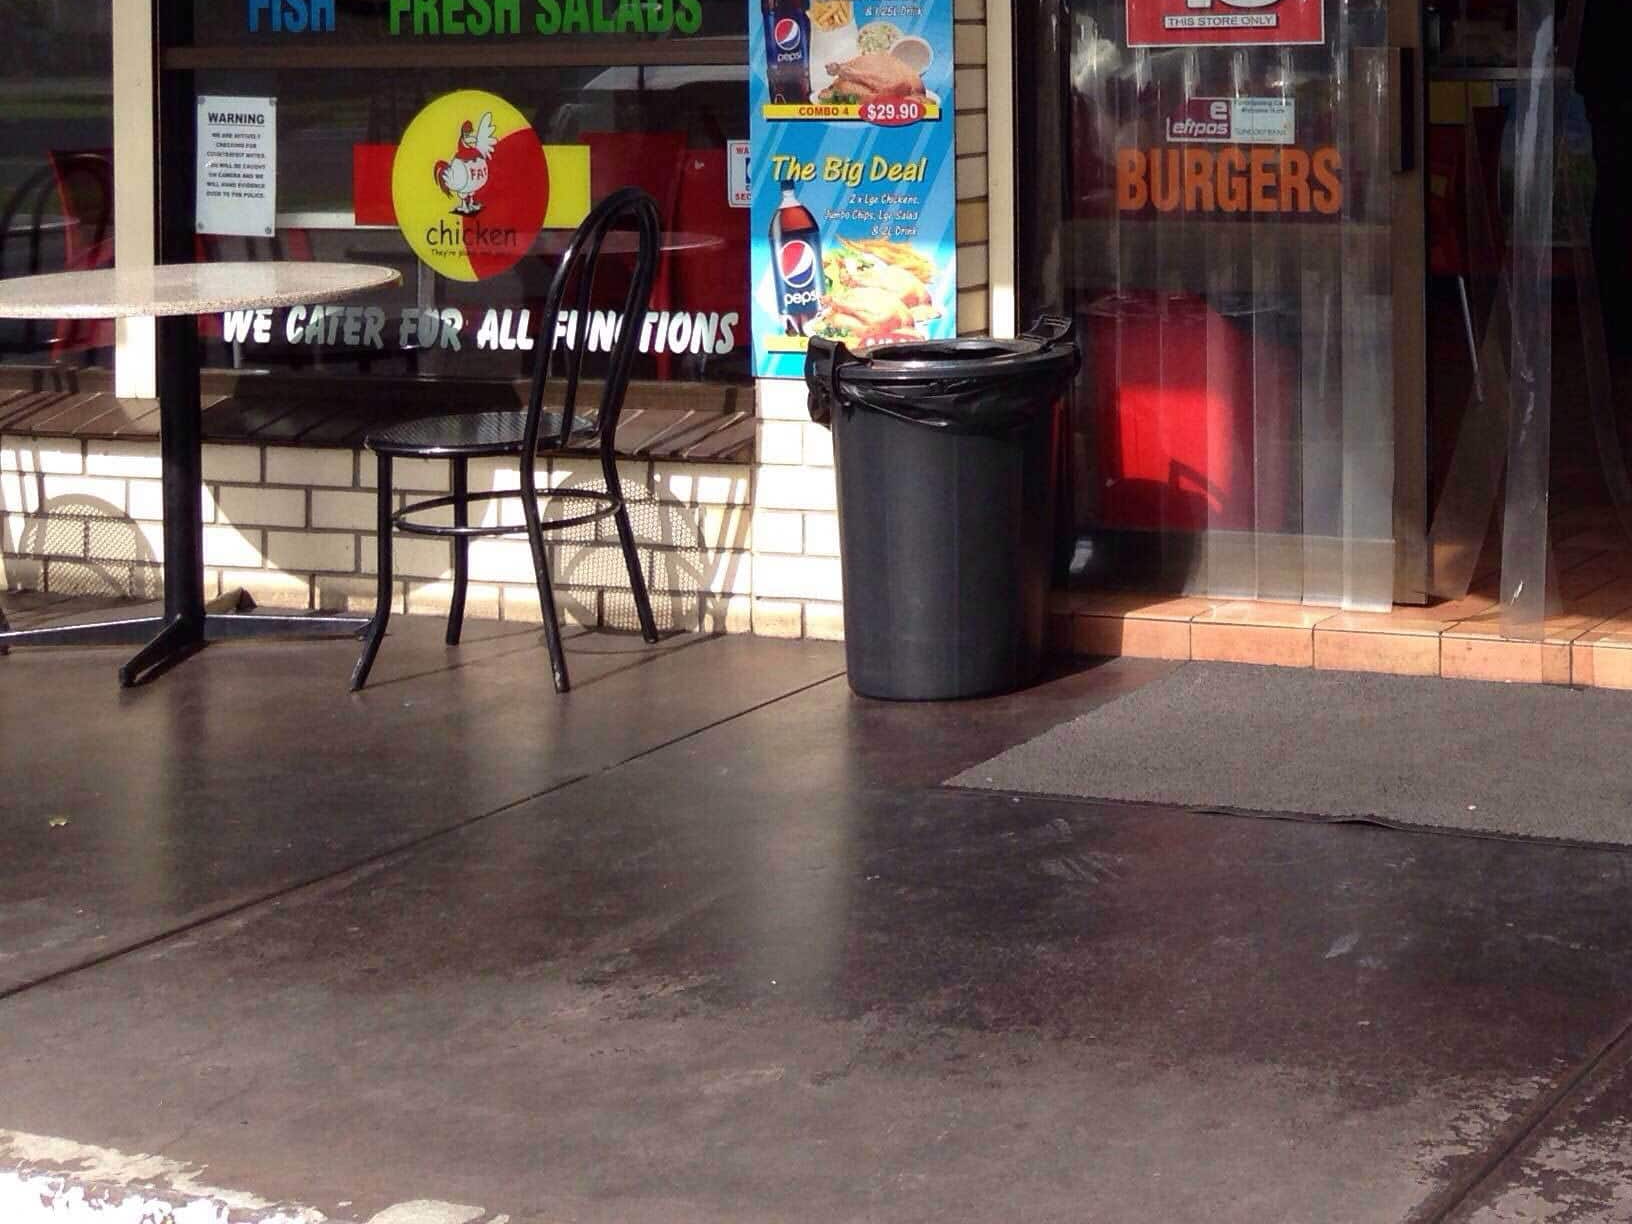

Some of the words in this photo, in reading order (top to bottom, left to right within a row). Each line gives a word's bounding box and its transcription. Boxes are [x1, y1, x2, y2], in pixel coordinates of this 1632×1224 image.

[1168, 16, 1195, 27] THIS
[1198, 16, 1240, 26] STORE
[1242, 14, 1274, 26] ONLY
[208, 112, 265, 125] WARNING
[799, 107, 838, 116] COMBO
[843, 107, 849, 116] 4
[868, 104, 918, 120] $29.90
[1172, 118, 1228, 136] eftpos
[771, 155, 816, 182] The
[823, 156, 864, 187] Big
[870, 156, 928, 182] Deal
[1116, 145, 1343, 214] BURGERS
[426, 219, 516, 247] chicken
[222, 308, 274, 344] WE
[286, 305, 386, 350] CATER
[399, 307, 464, 353] FOR
[477, 308, 534, 352] ALL
